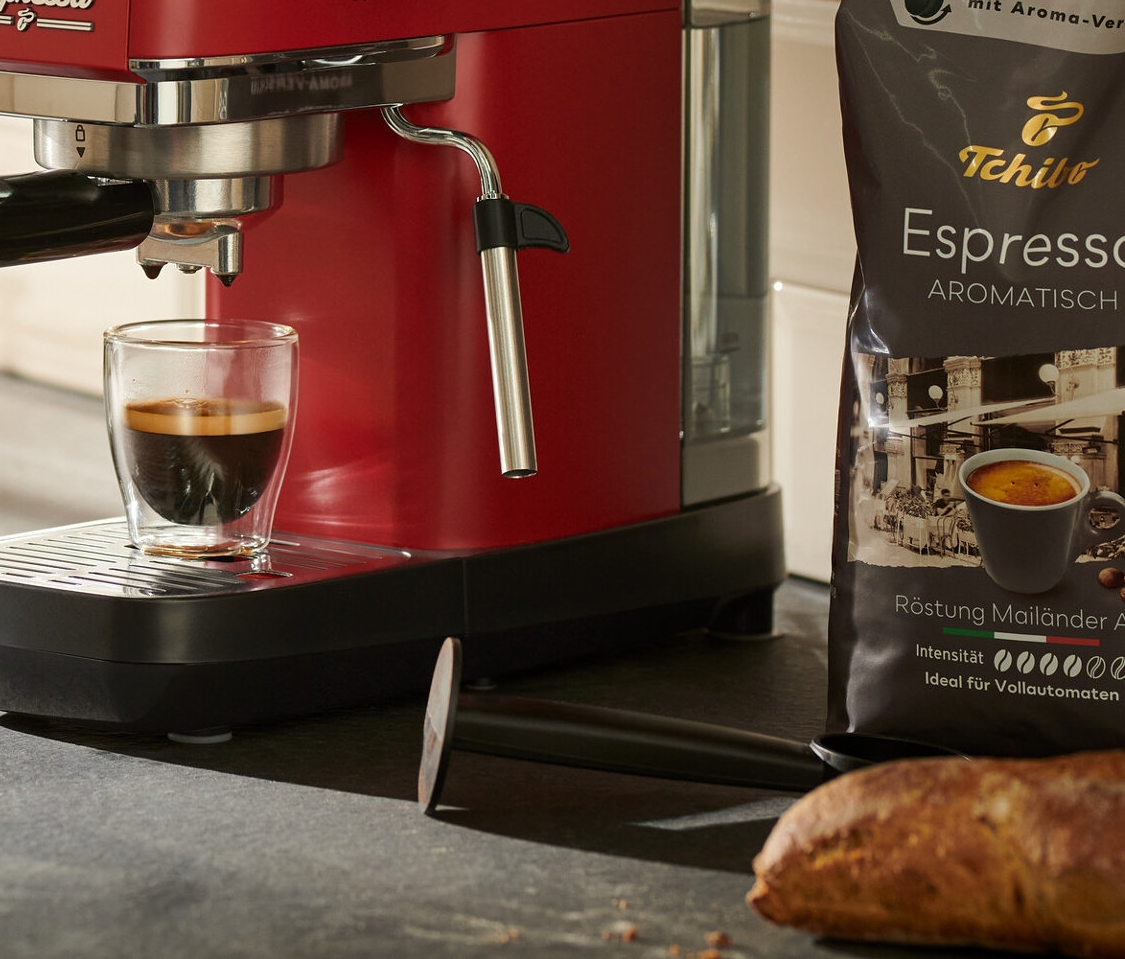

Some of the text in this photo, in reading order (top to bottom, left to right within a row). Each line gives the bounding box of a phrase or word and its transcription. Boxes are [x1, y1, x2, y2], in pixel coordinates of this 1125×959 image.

[1011, 1, 1125, 29] Aroma-Ver
[958, 144, 1100, 189] Tchibo
[927, 279, 1118, 310] AROMATISCH
[895, 594, 985, 626] Röstung
[992, 603, 1108, 630] Mailänder
[916, 643, 984, 665] Intensität
[925, 671, 1120, 702] Ideal für Vollautomaten
